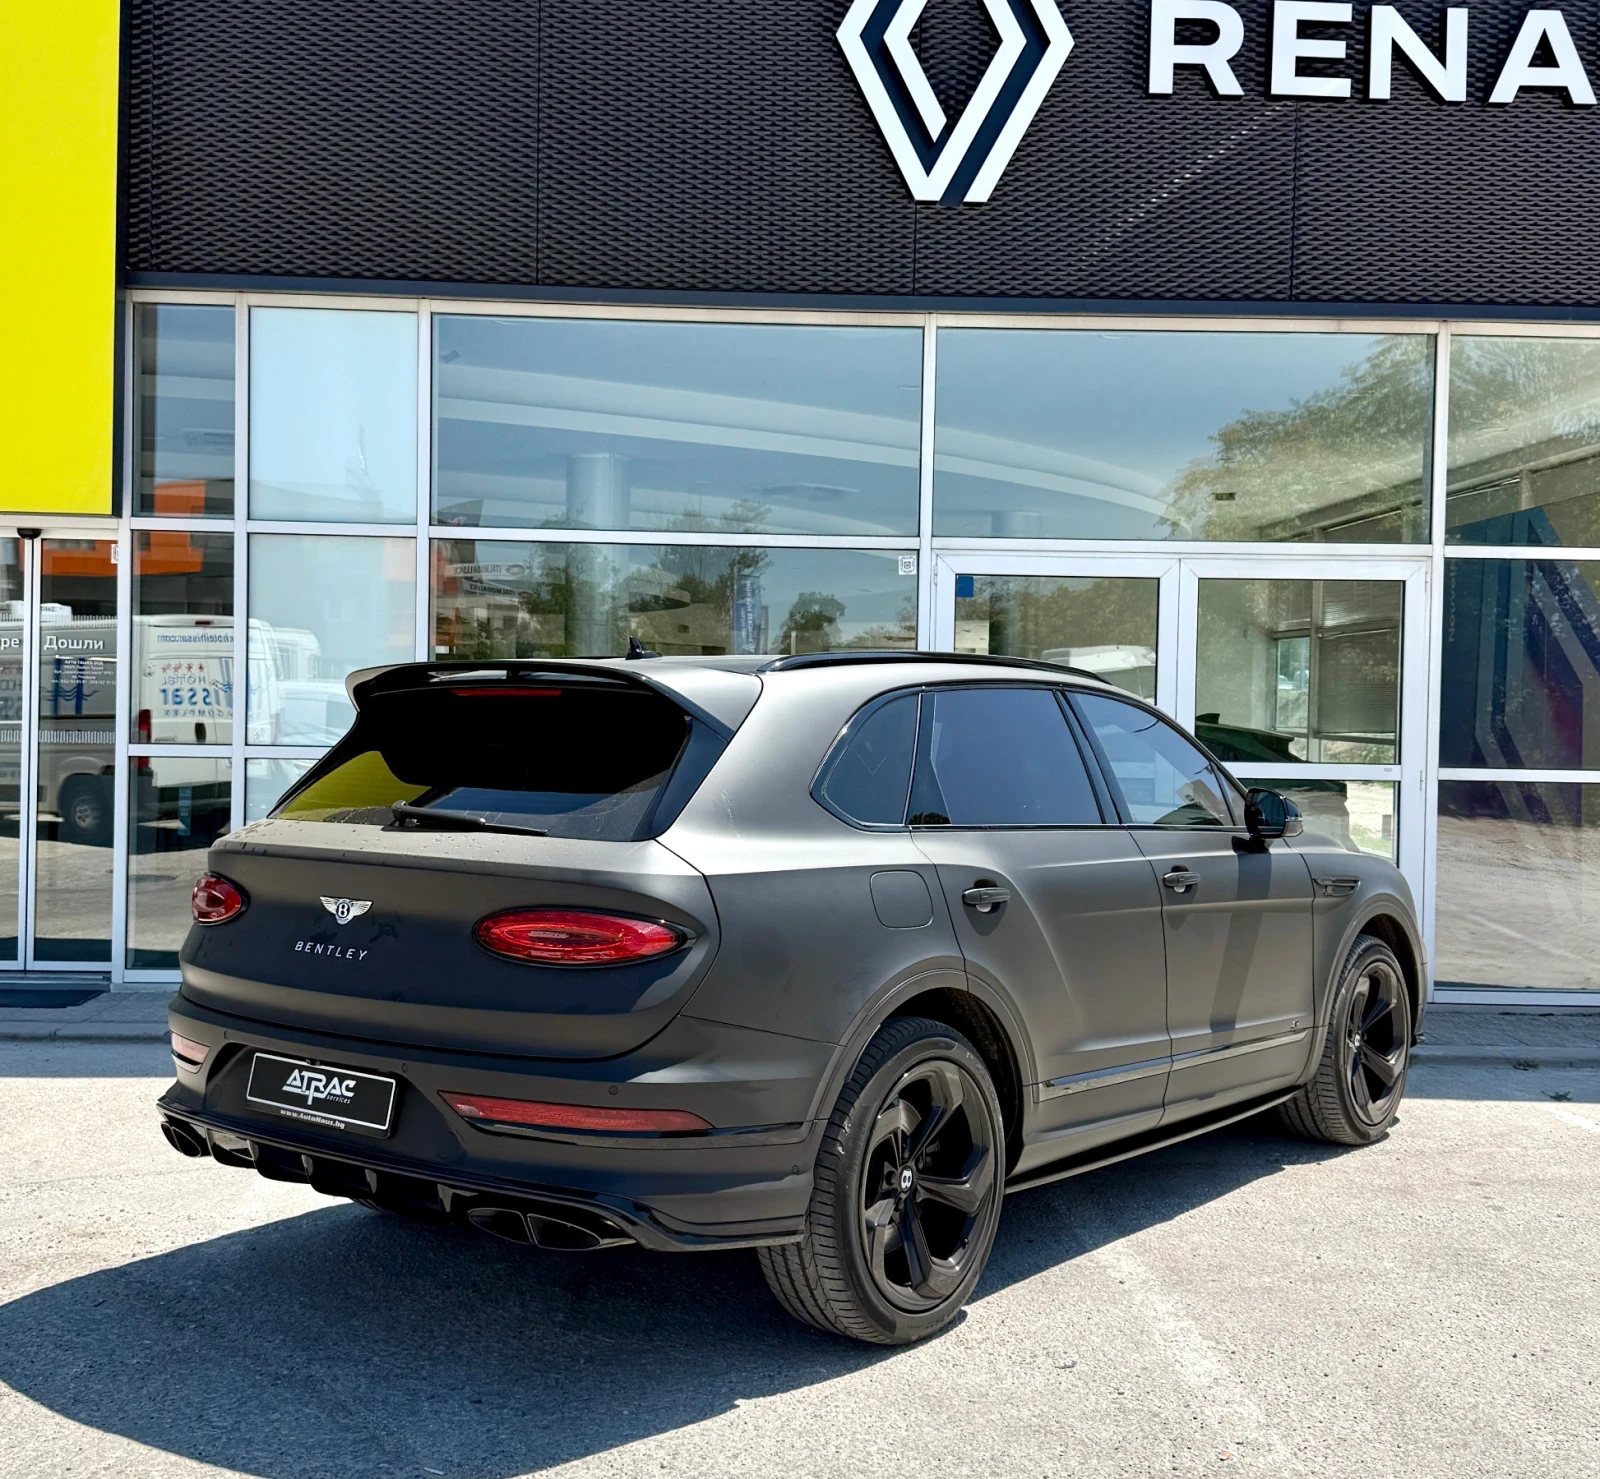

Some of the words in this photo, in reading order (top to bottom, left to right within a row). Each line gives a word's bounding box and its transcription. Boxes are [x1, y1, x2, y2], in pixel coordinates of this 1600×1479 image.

[1149, 0, 1598, 105] RENA
[44, 635, 104, 651] Дошли
[294, 941, 368, 961] BENTLEY
[326, 1094, 351, 1105] services
[280, 1109, 346, 1130] www.AutoHaus.bg
